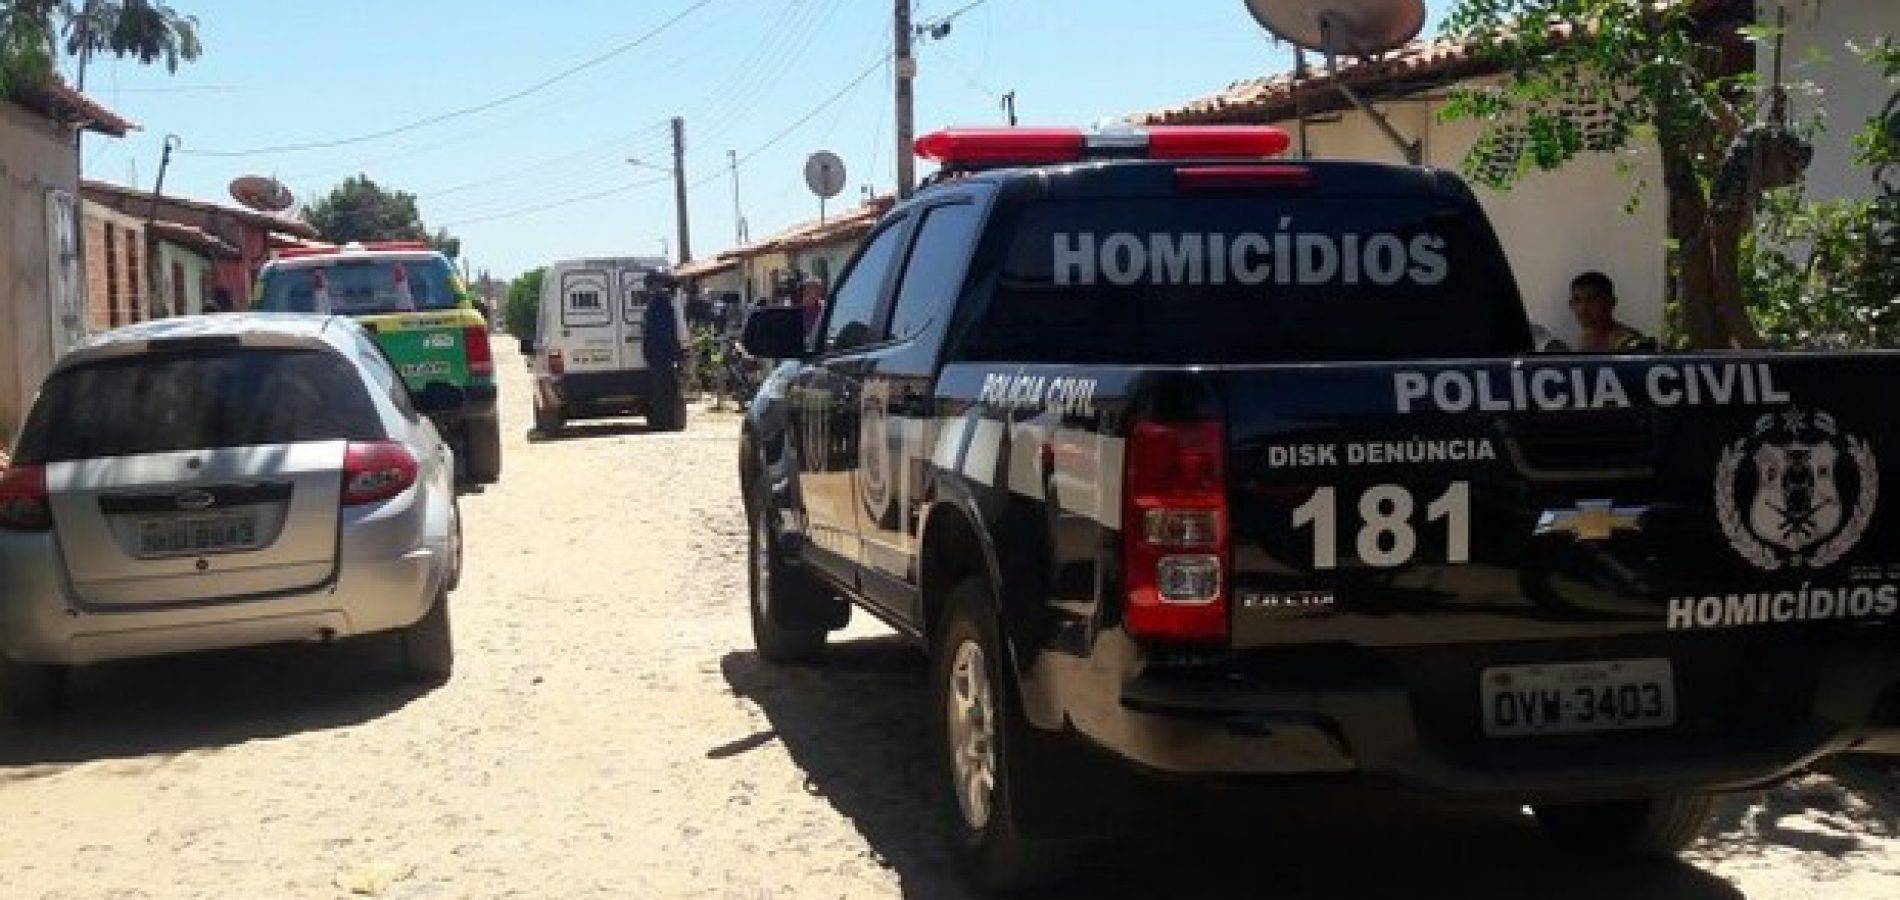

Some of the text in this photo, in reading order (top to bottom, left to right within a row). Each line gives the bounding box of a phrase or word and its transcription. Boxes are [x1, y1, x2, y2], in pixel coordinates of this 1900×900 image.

[1053, 216, 1448, 286] HOMICÍDIOS
[979, 365, 1098, 417] POLÍCIA CIVIL
[1394, 360, 1791, 414] POLÍCIA CIVIL
[1268, 435, 1497, 468] DISK DENÚNCIA
[1292, 480, 1471, 570] 181
[1666, 581, 1898, 630] HOMICÍDIOS
